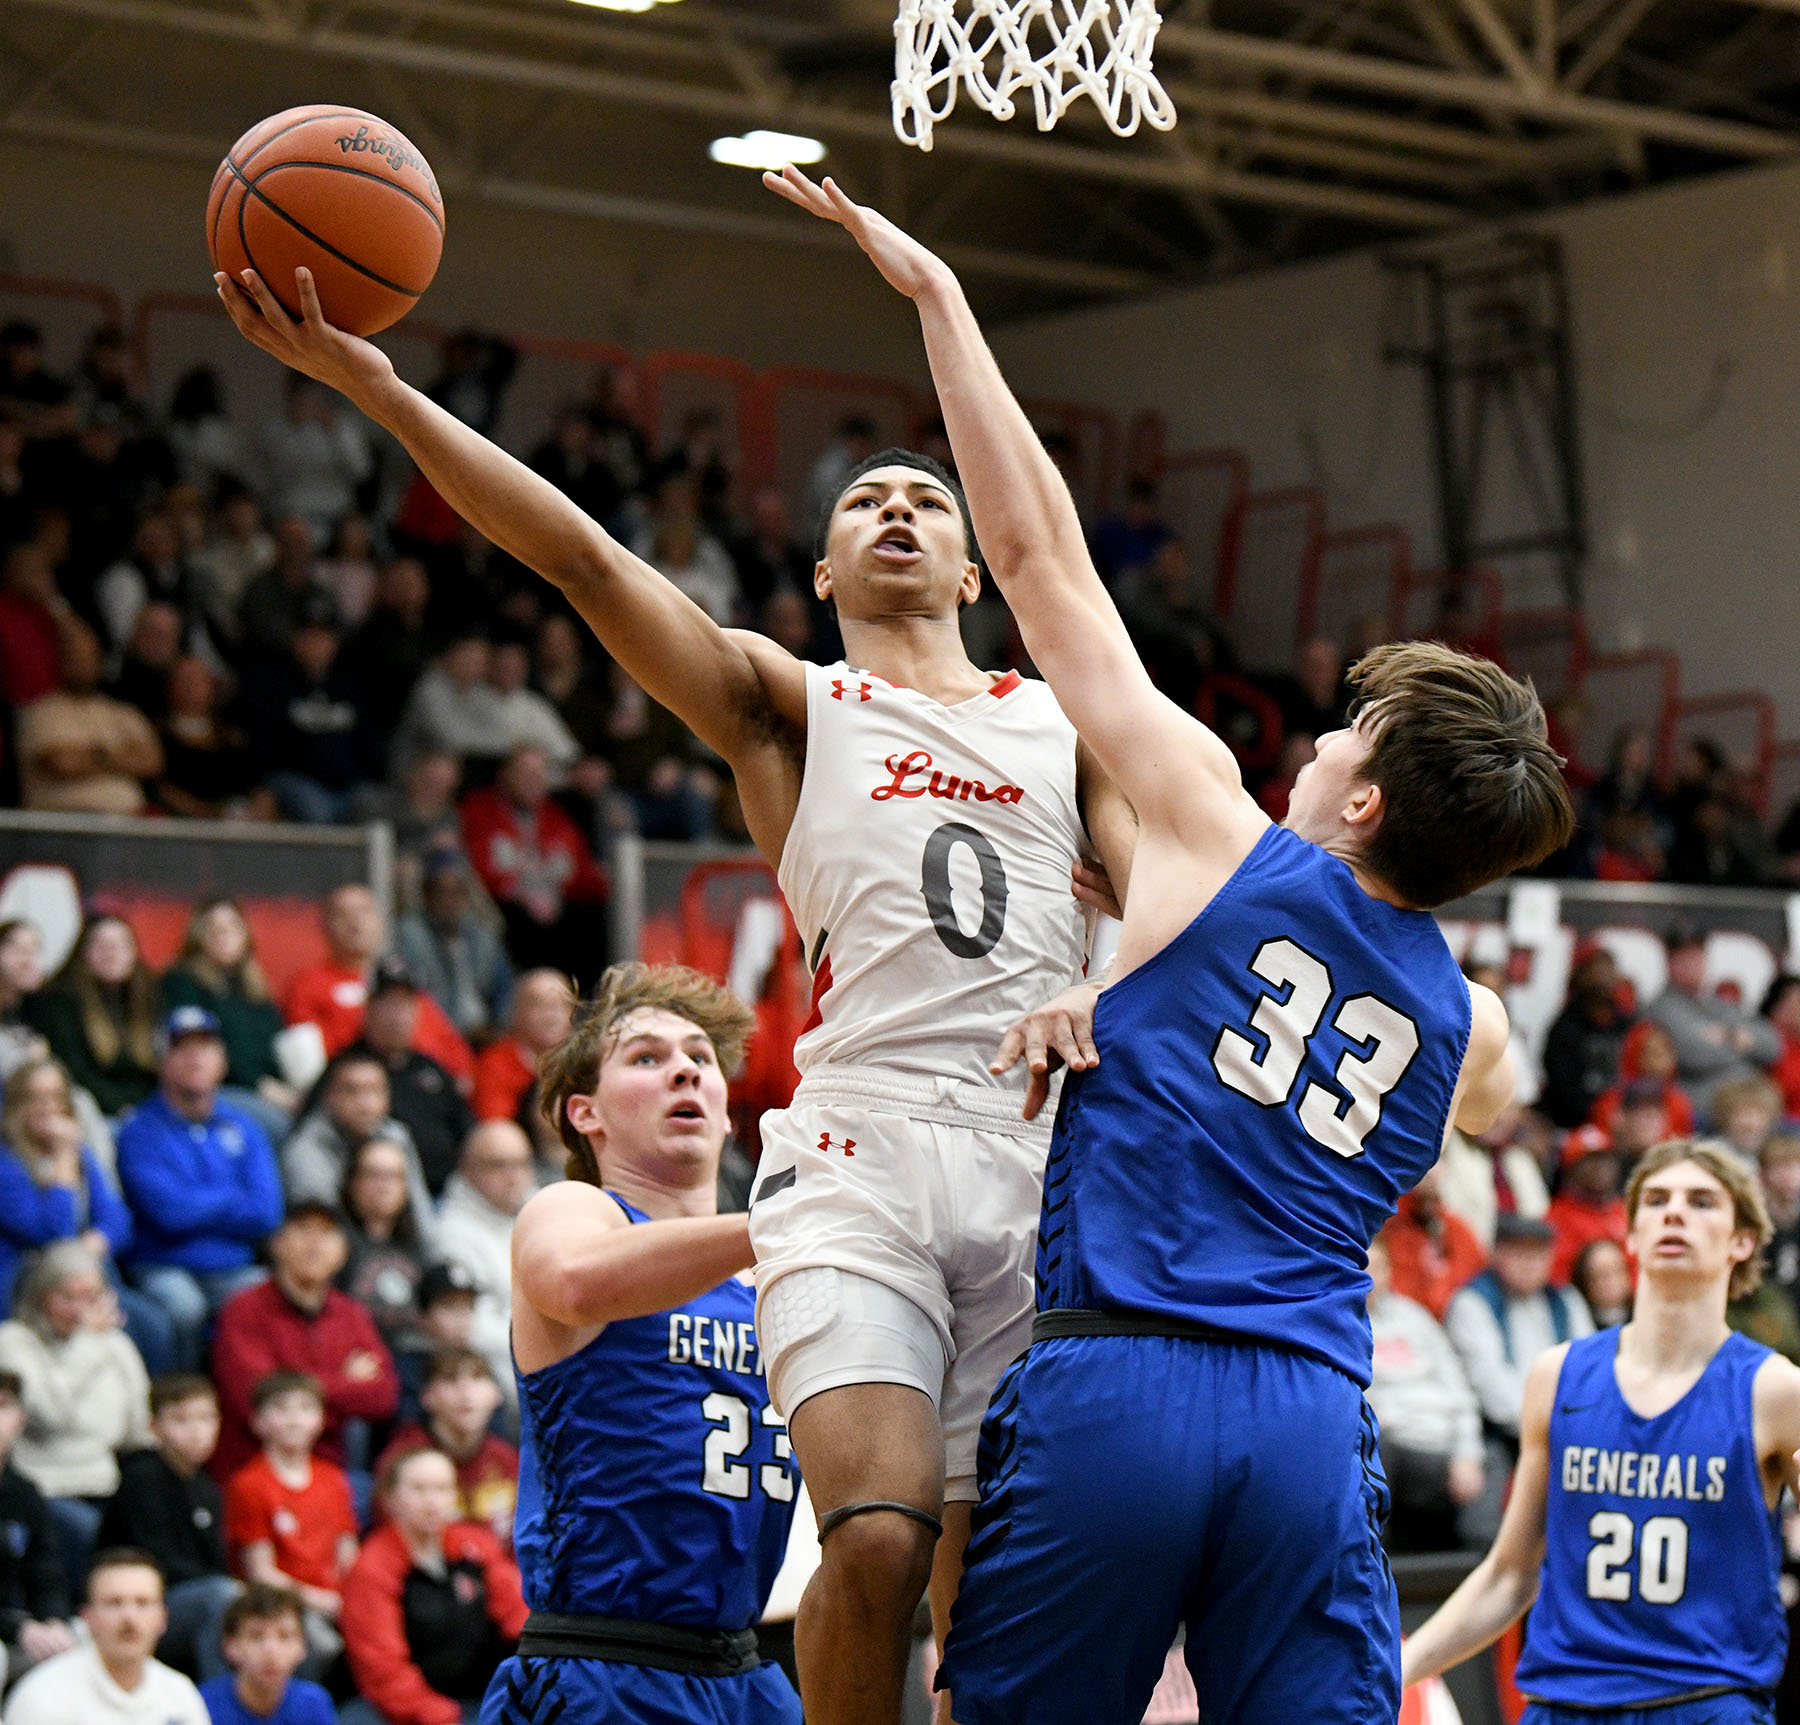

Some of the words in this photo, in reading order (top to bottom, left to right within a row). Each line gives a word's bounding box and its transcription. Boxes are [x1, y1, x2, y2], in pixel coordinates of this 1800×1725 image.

[870, 750, 1025, 805] Luna
[919, 822, 1010, 959] 0
[1208, 934, 1423, 1161] 33
[668, 1313, 764, 1377] GENE
[1562, 1445, 1727, 1502] GENERALS
[1586, 1511, 1689, 1605] 20
